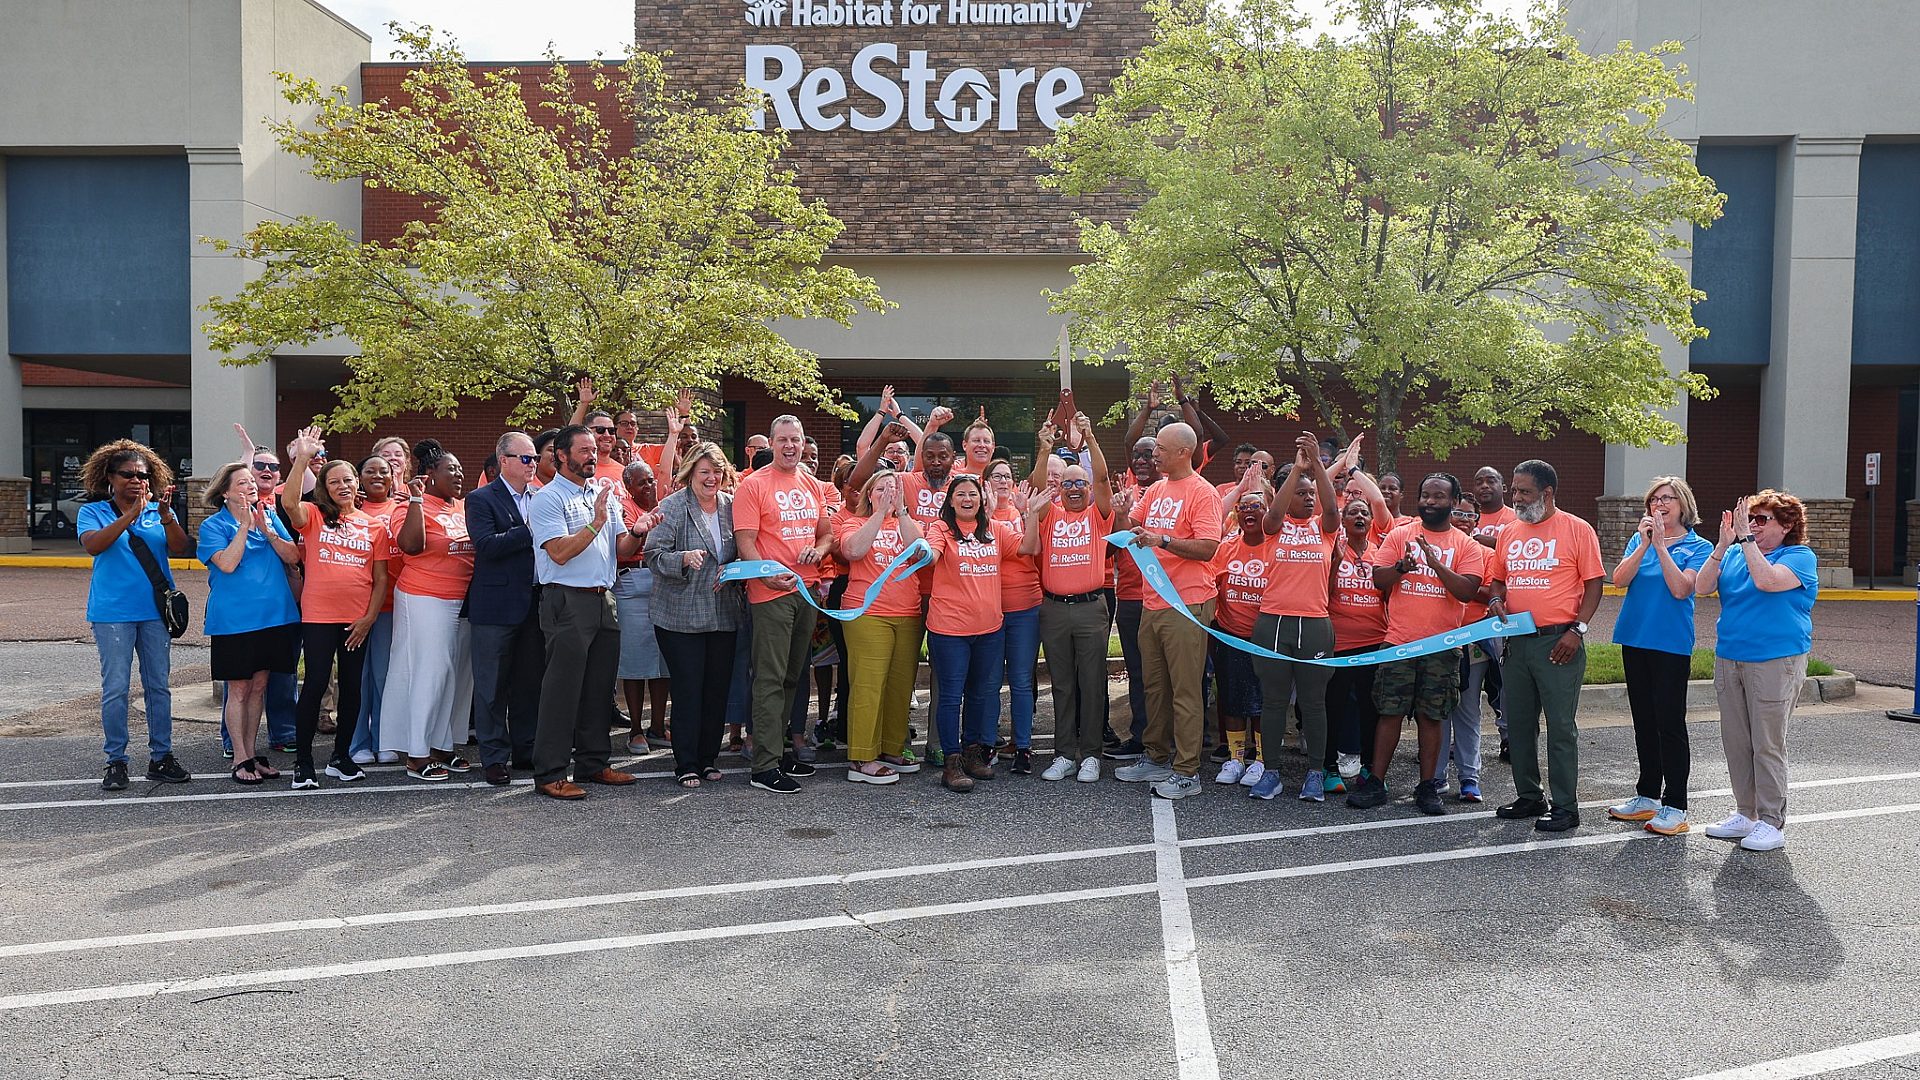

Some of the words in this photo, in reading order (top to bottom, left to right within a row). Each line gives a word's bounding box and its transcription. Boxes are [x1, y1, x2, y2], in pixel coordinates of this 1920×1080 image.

[792, 0, 893, 26] Habitat
[900, 0, 941, 25] for
[948, 0, 1084, 30] Humanity
[745, 43, 1085, 132] ReStore
[774, 488, 817, 510] 901
[917, 488, 948, 508] 90
[1149, 496, 1184, 519] 901
[780, 508, 818, 522] RESTORE
[916, 505, 943, 518] REST
[1053, 516, 1091, 538] 901
[319, 531, 372, 551] RESTORE
[1051, 534, 1091, 548] RESTORE
[1507, 537, 1557, 560] 901
[334, 551, 367, 565] ReStore
[1061, 553, 1092, 563] ReStore
[1290, 550, 1324, 560] ReStore
[1227, 559, 1270, 578] 90
[1338, 560, 1374, 580] 90
[1227, 575, 1268, 589] RESTOR
[1337, 578, 1378, 591] RESTO
[1515, 576, 1550, 586] ReStore
